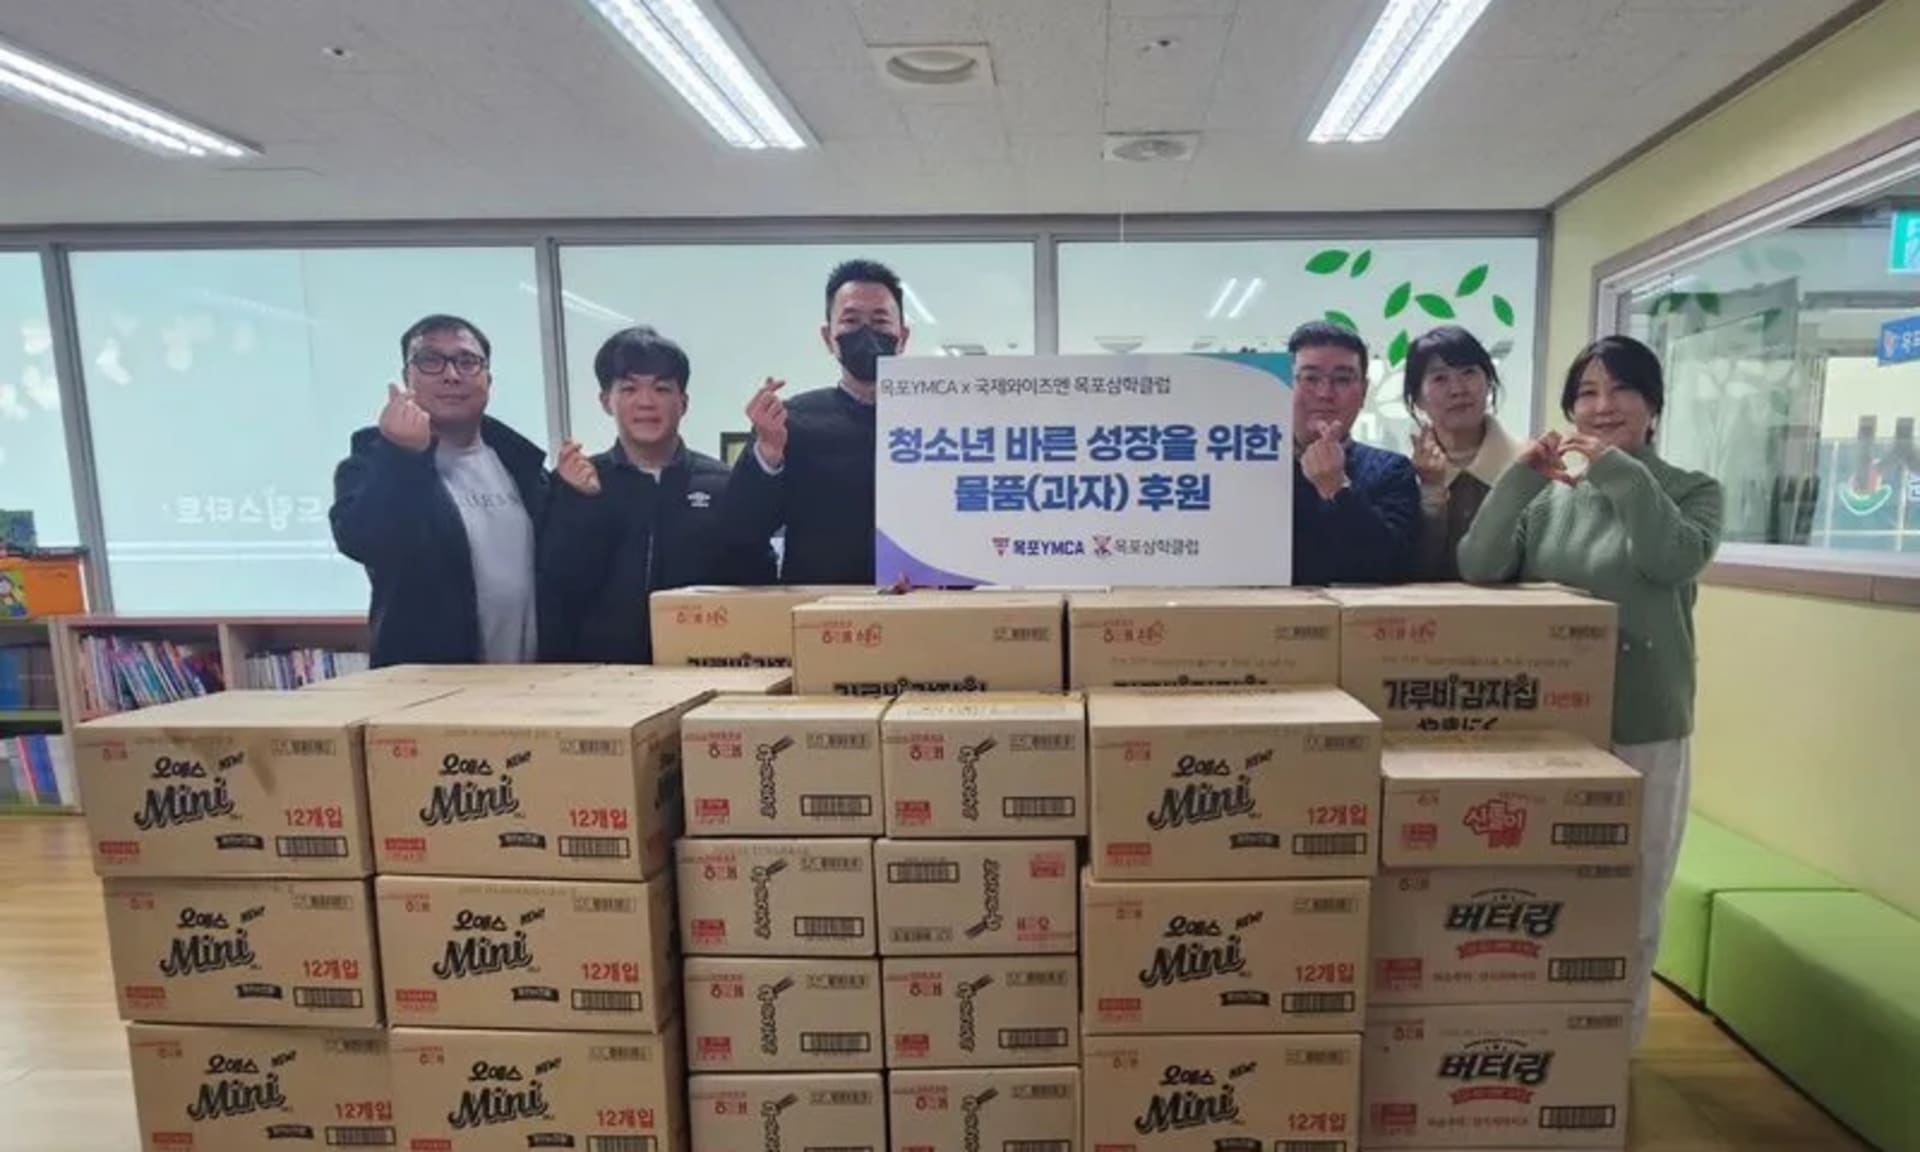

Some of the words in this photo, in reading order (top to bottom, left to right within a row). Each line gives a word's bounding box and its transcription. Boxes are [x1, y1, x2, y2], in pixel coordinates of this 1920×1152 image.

[880, 377, 958, 396] 목포YMCA
[1074, 376, 1171, 396] 목포삼학클럽
[888, 426, 995, 464] 청소년
[1006, 425, 1078, 462] 바른
[1086, 424, 1197, 462] 성장을
[1206, 424, 1282, 462] 위한
[954, 474, 1129, 513] 물품(과자)
[1137, 474, 1211, 511] 후원
[1013, 539, 1085, 556] 목포YMCA
[134, 778, 234, 830] Mini
[285, 807, 342, 828] 12개입
[420, 775, 519, 826] Mini
[1148, 775, 1255, 830] Mini
[1308, 804, 1367, 826] 12개입
[570, 809, 627, 830] 12개입
[1444, 902, 1565, 938] 버터링
[160, 929, 255, 977] Mini
[304, 960, 358, 979] 12개입
[433, 932, 533, 980] Mini
[1140, 935, 1245, 989] Mini
[582, 962, 638, 982] 12개입
[1296, 962, 1354, 984] 12개입
[1438, 1050, 1556, 1086] 버터링
[188, 1073, 286, 1121] Mini
[336, 1102, 392, 1121] 12개입
[449, 1080, 548, 1129] Mini
[1135, 1084, 1239, 1135] Mini
[597, 1109, 654, 1128] 12개입
[1289, 1113, 1345, 1132] 12개입
